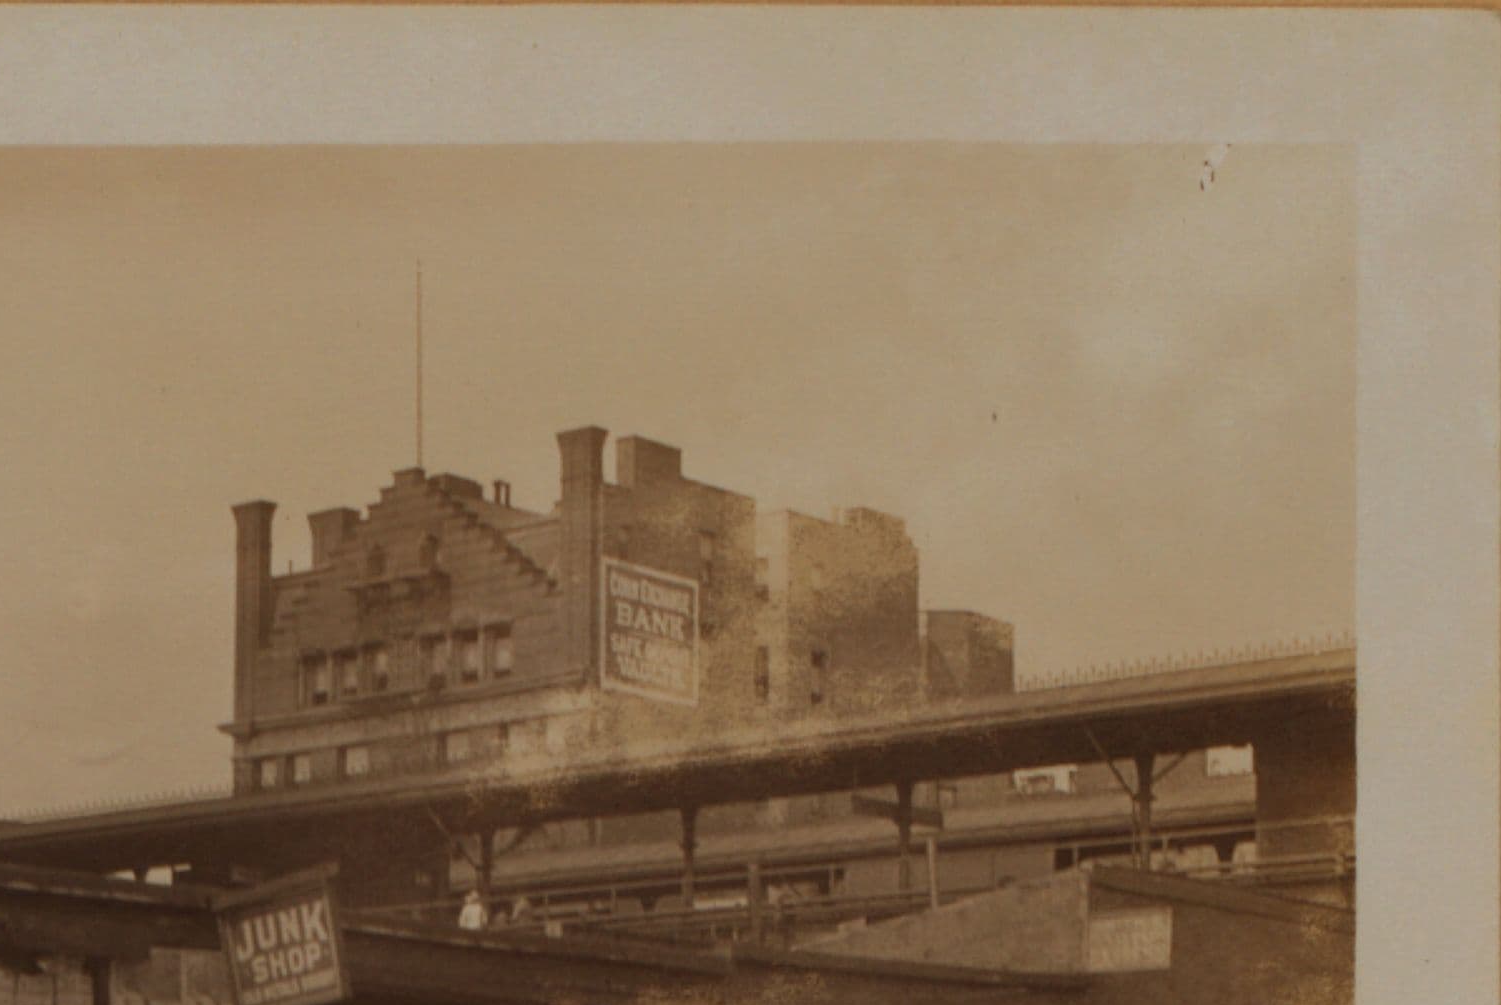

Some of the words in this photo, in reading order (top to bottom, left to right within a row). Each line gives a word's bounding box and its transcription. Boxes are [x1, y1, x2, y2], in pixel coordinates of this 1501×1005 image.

[615, 600, 685, 641] BANK
[236, 900, 328, 962] JUNK
[251, 942, 322, 984] SHOP
